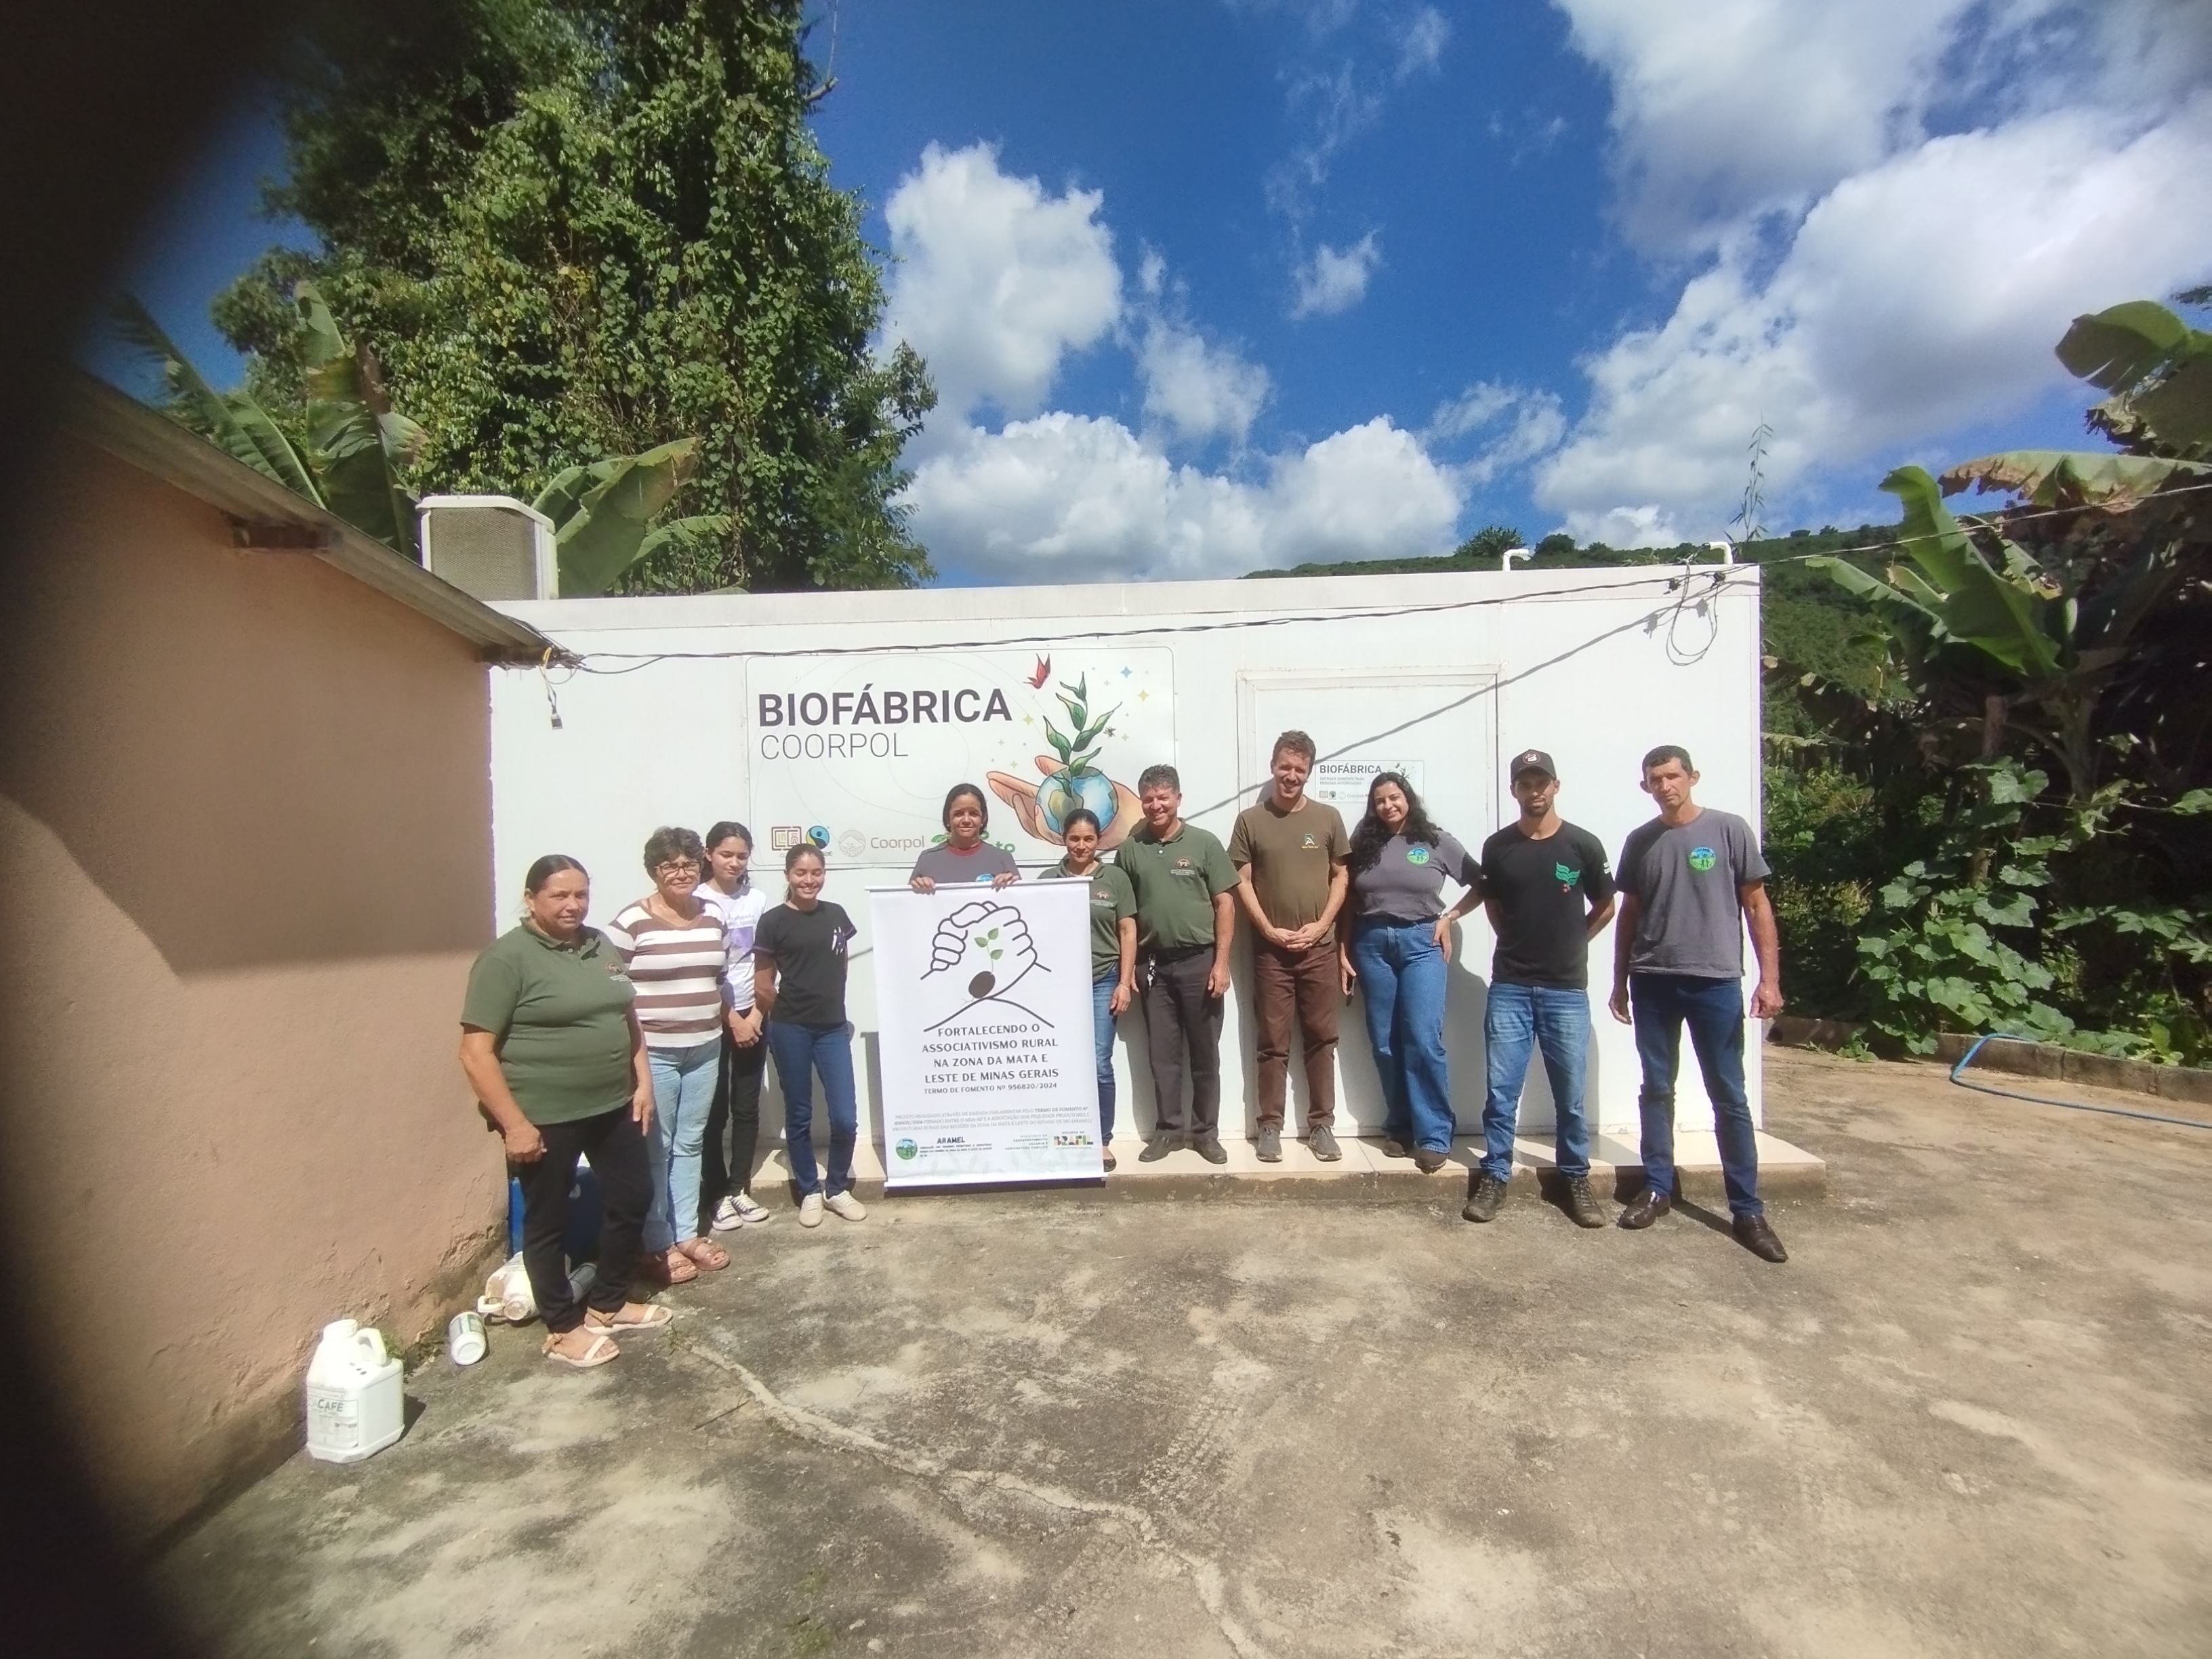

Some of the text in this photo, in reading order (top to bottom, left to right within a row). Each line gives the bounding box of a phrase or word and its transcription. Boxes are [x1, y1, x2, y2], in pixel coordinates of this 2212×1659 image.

[758, 683, 1013, 727] BIOFÁBRICA
[760, 732, 909, 760] COORPOL
[1319, 763, 1382, 773] BIOFÁBRICA
[870, 836, 924, 851] Coorpol
[938, 1023, 1040, 1037] FORTALECENDO O
[922, 1038, 1059, 1052] ASSOCIATIVISMO RURAL
[934, 1054, 1048, 1067] NA ZONA DA MATA E
[925, 1069, 1059, 1083] LESTE DE MINAS GERAIS
[961, 1084, 995, 1092] FOMENTO
[937, 1136, 965, 1145] ARAMEL
